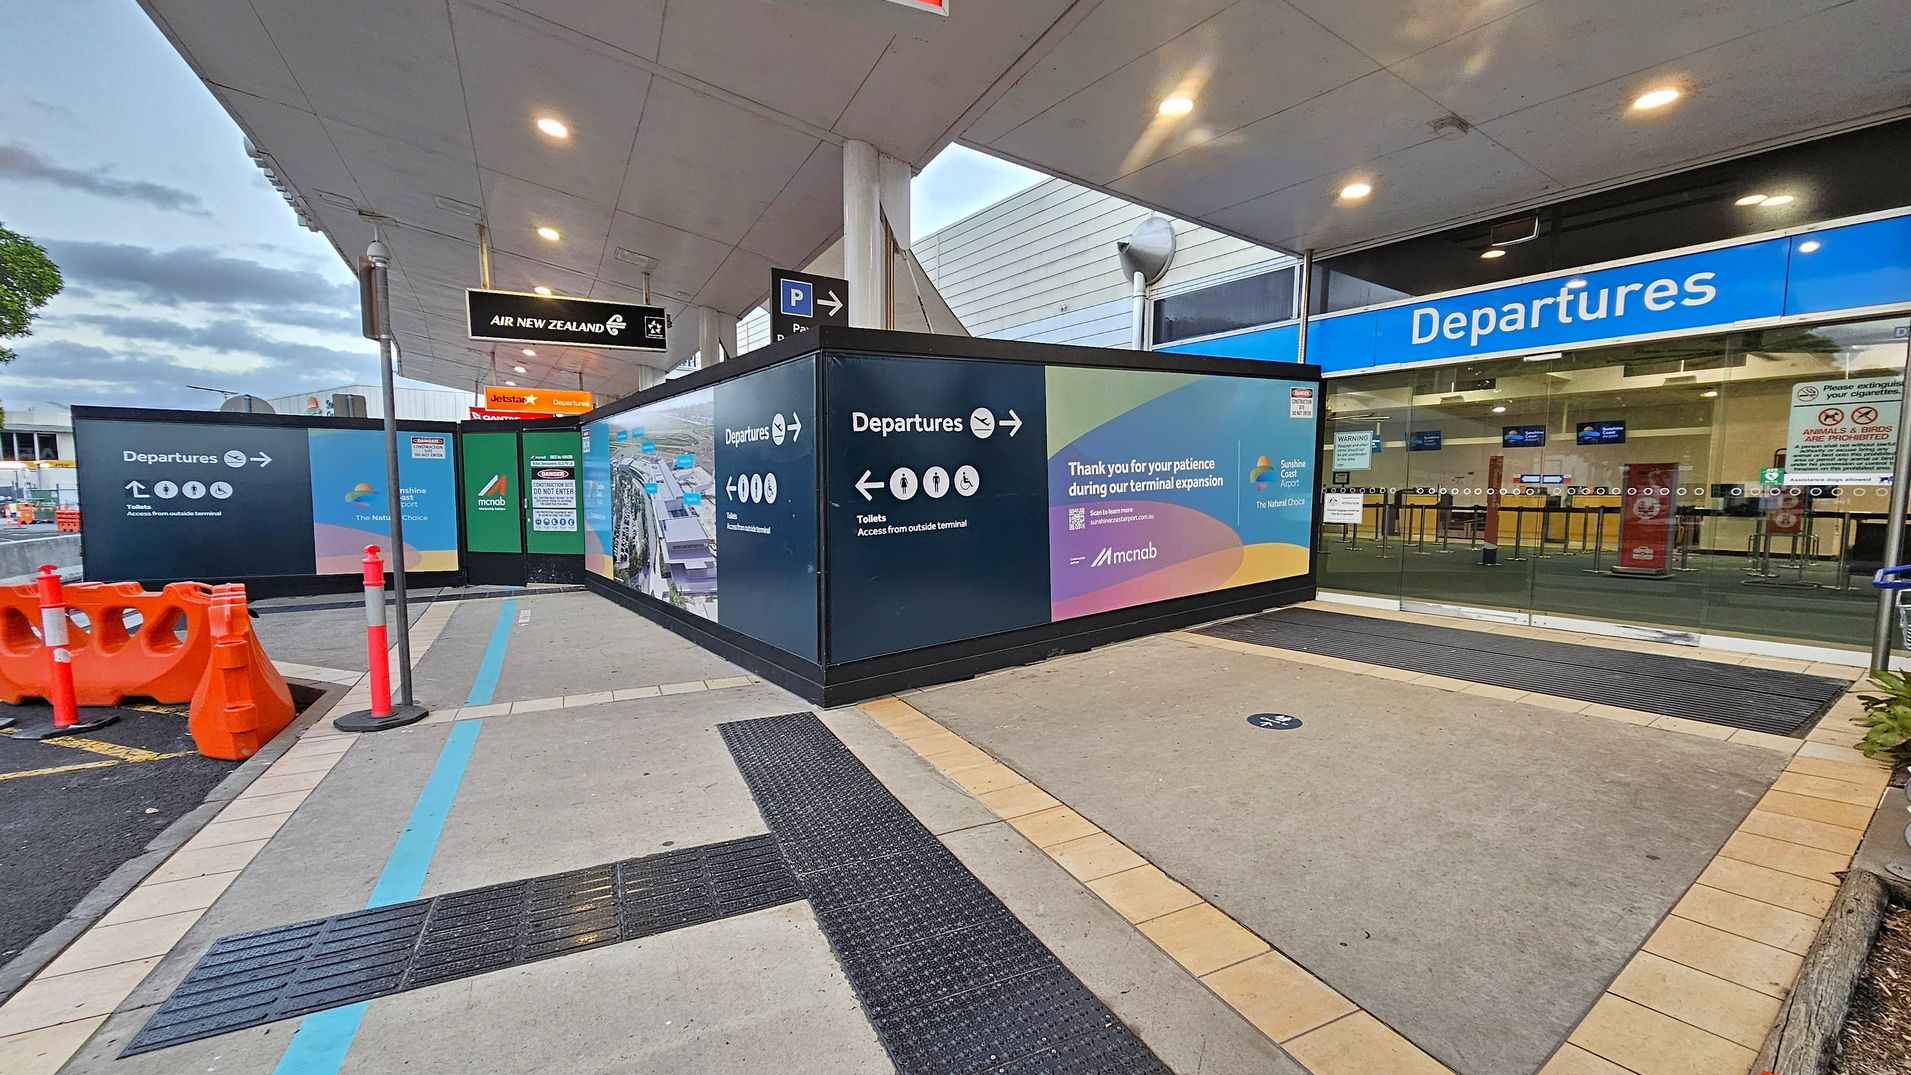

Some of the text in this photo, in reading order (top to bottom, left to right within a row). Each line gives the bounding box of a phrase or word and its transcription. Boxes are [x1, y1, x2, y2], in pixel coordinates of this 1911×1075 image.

[790, 288, 804, 306] P
[1411, 272, 1717, 346] Departures
[490, 314, 604, 333] AIR NEW ZEALAND
[1856, 380, 1904, 390] extinguis
[490, 394, 590, 408] Jetstar Departures
[1826, 388, 1901, 400] your cigarettes.
[852, 412, 963, 436] Departures
[725, 424, 769, 447] Departures
[1828, 433, 1889, 442] PROHIBITED
[123, 450, 218, 464] Departures
[1281, 459, 1306, 468] Sunshine
[1068, 458, 1215, 477] Thank you for your patience
[1281, 470, 1297, 478] Coast
[1068, 475, 1223, 498] during our terminal expansion
[1280, 479, 1300, 489] Airport
[478, 496, 505, 506] mcnab
[1256, 501, 1266, 509] The
[1268, 499, 1287, 508] Natural
[857, 514, 886, 524] Toilets
[1090, 514, 1155, 525] sunshinecoastairport.com.au
[858, 520, 967, 536] Access from outside terminal
[1114, 541, 1157, 564] mcnab
